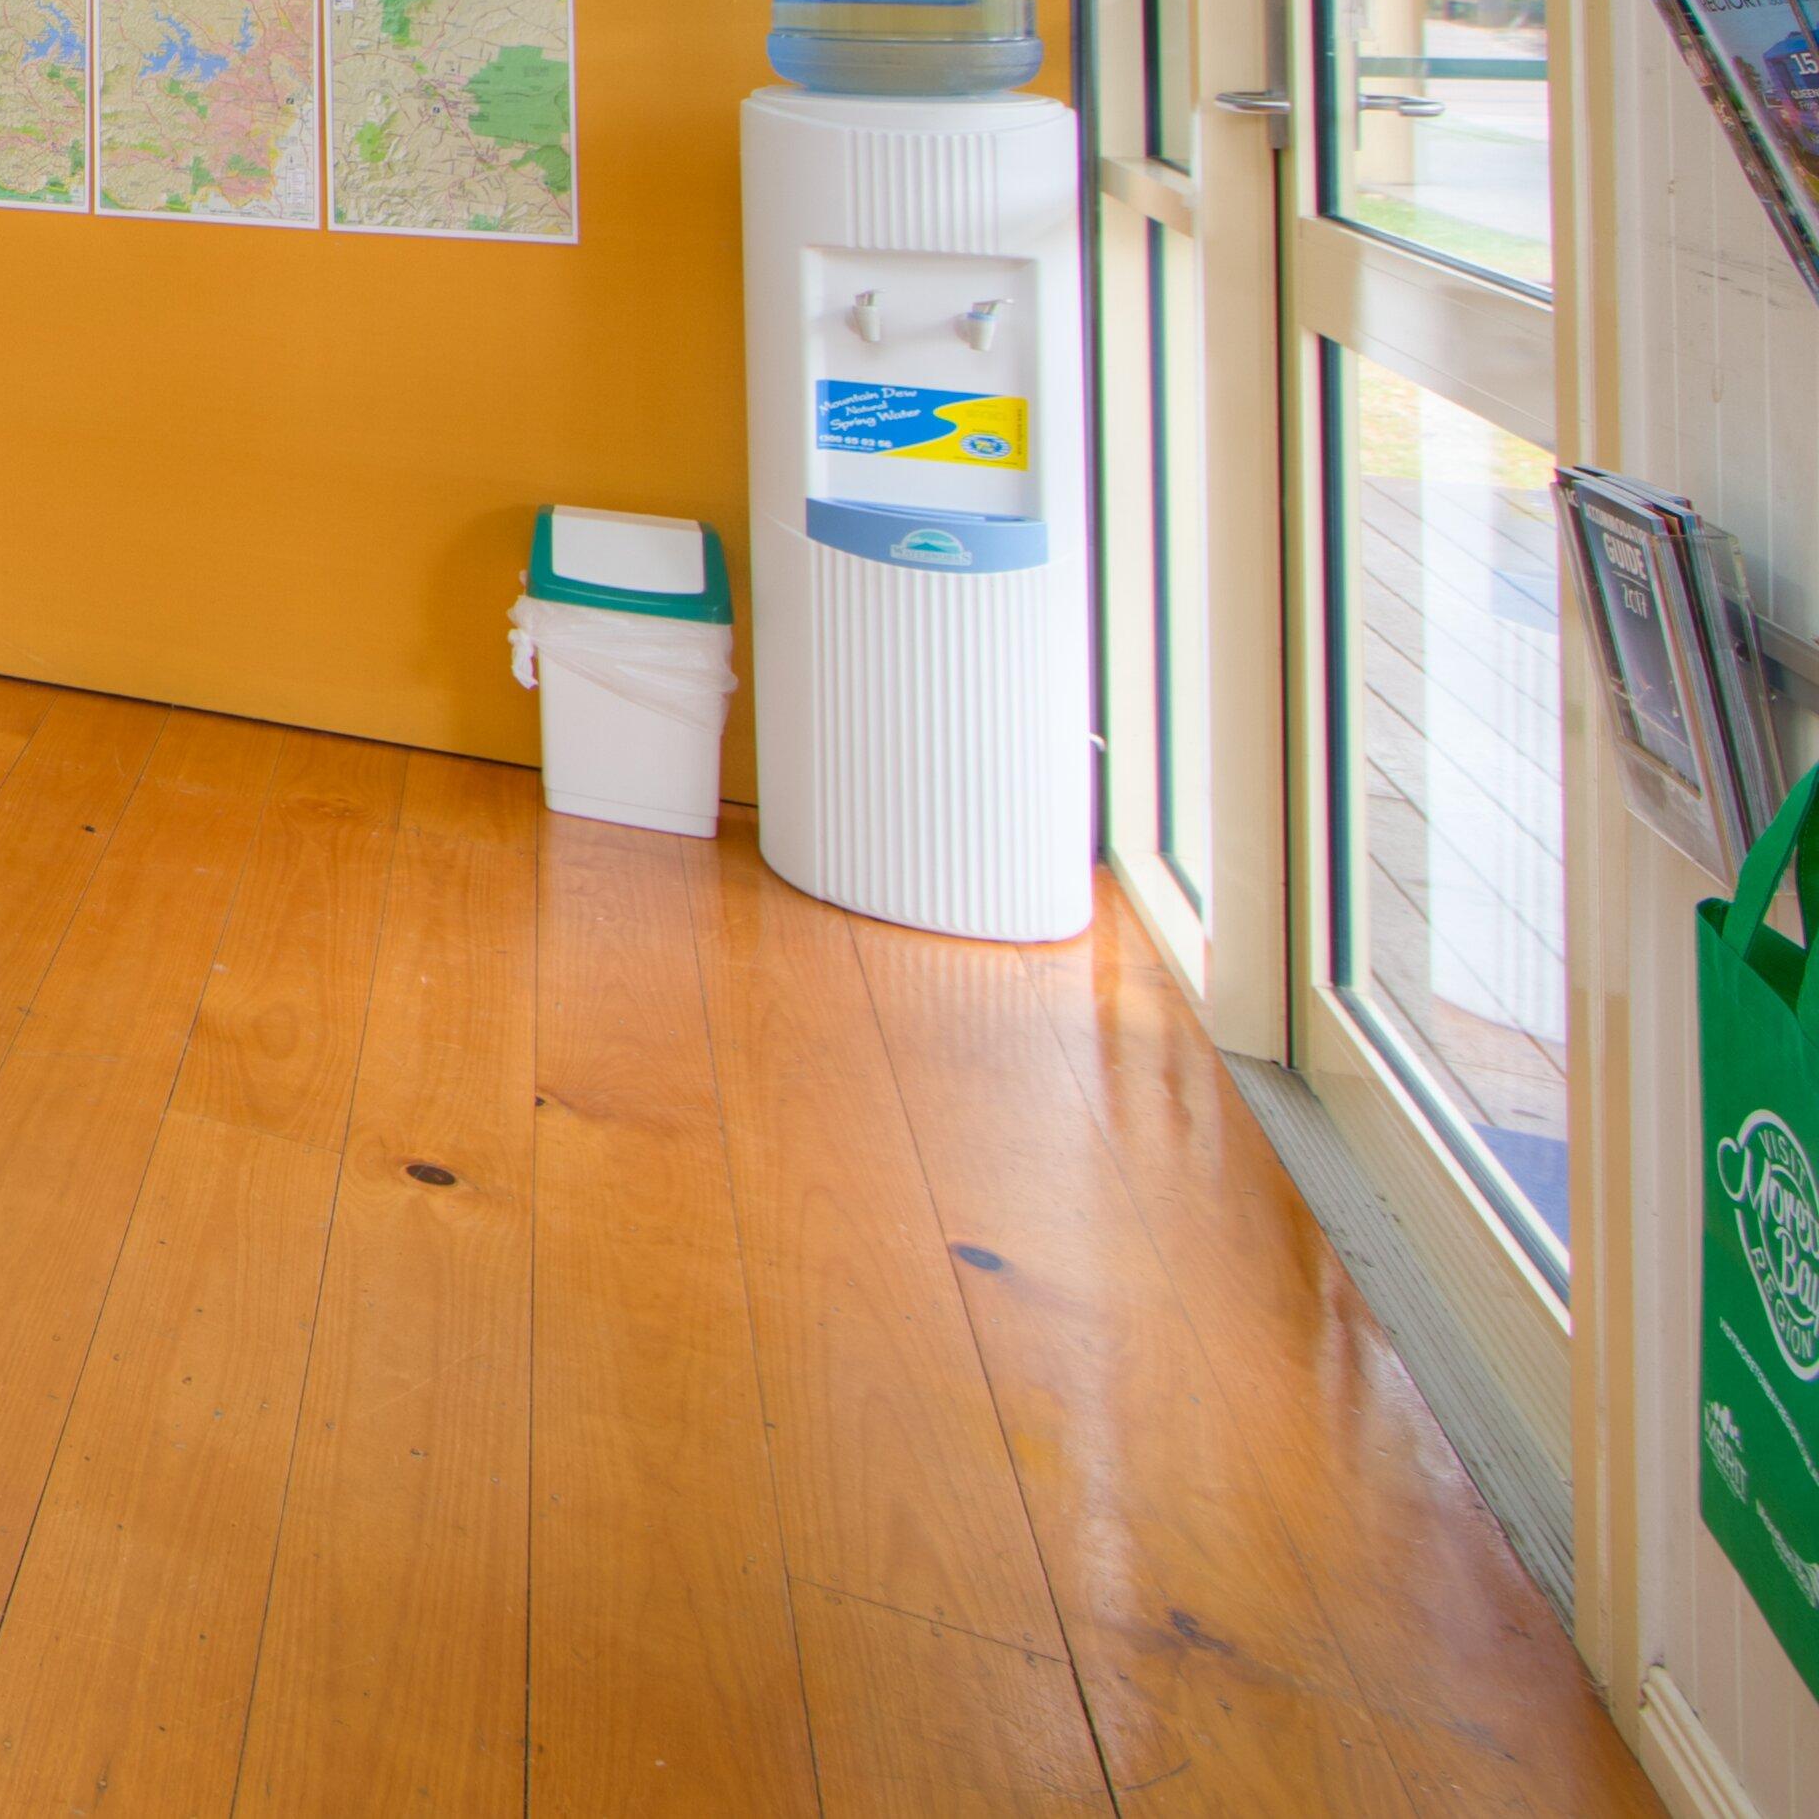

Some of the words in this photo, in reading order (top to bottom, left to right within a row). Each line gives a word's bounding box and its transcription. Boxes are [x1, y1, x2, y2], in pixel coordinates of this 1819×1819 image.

[818, 391, 880, 416] Mountain
[881, 386, 918, 399] Dew
[829, 417, 877, 431] Spring
[877, 408, 922, 422] Water
[844, 400, 889, 416] Natural
[1603, 532, 1647, 581] GUIDE
[1758, 1130, 1807, 1188] VISIT
[1750, 1246, 1814, 1359] REGION
